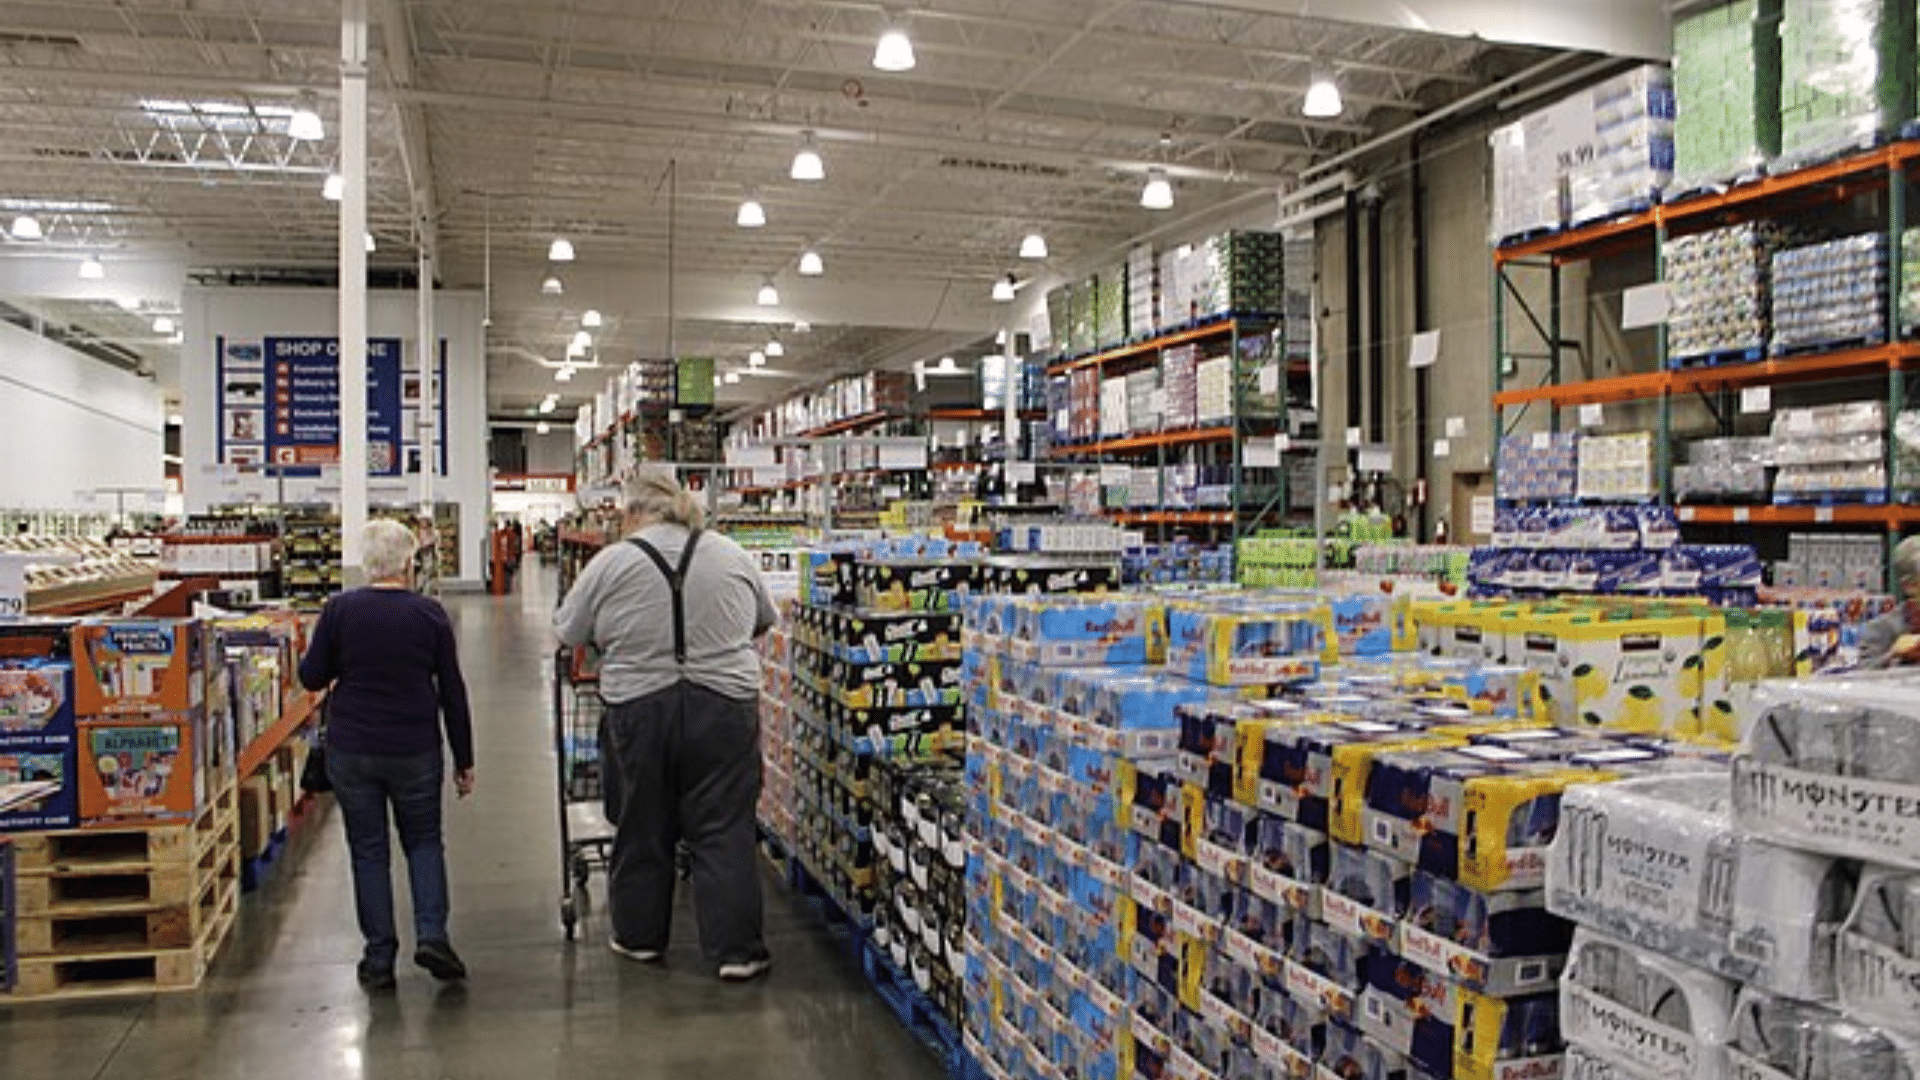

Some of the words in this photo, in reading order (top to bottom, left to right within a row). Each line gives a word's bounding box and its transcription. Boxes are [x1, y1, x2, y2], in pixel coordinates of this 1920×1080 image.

[275, 342, 322, 356] SHOP
[1607, 833, 1692, 876] MONSTER
[1591, 1004, 1691, 1066] MONSTER
